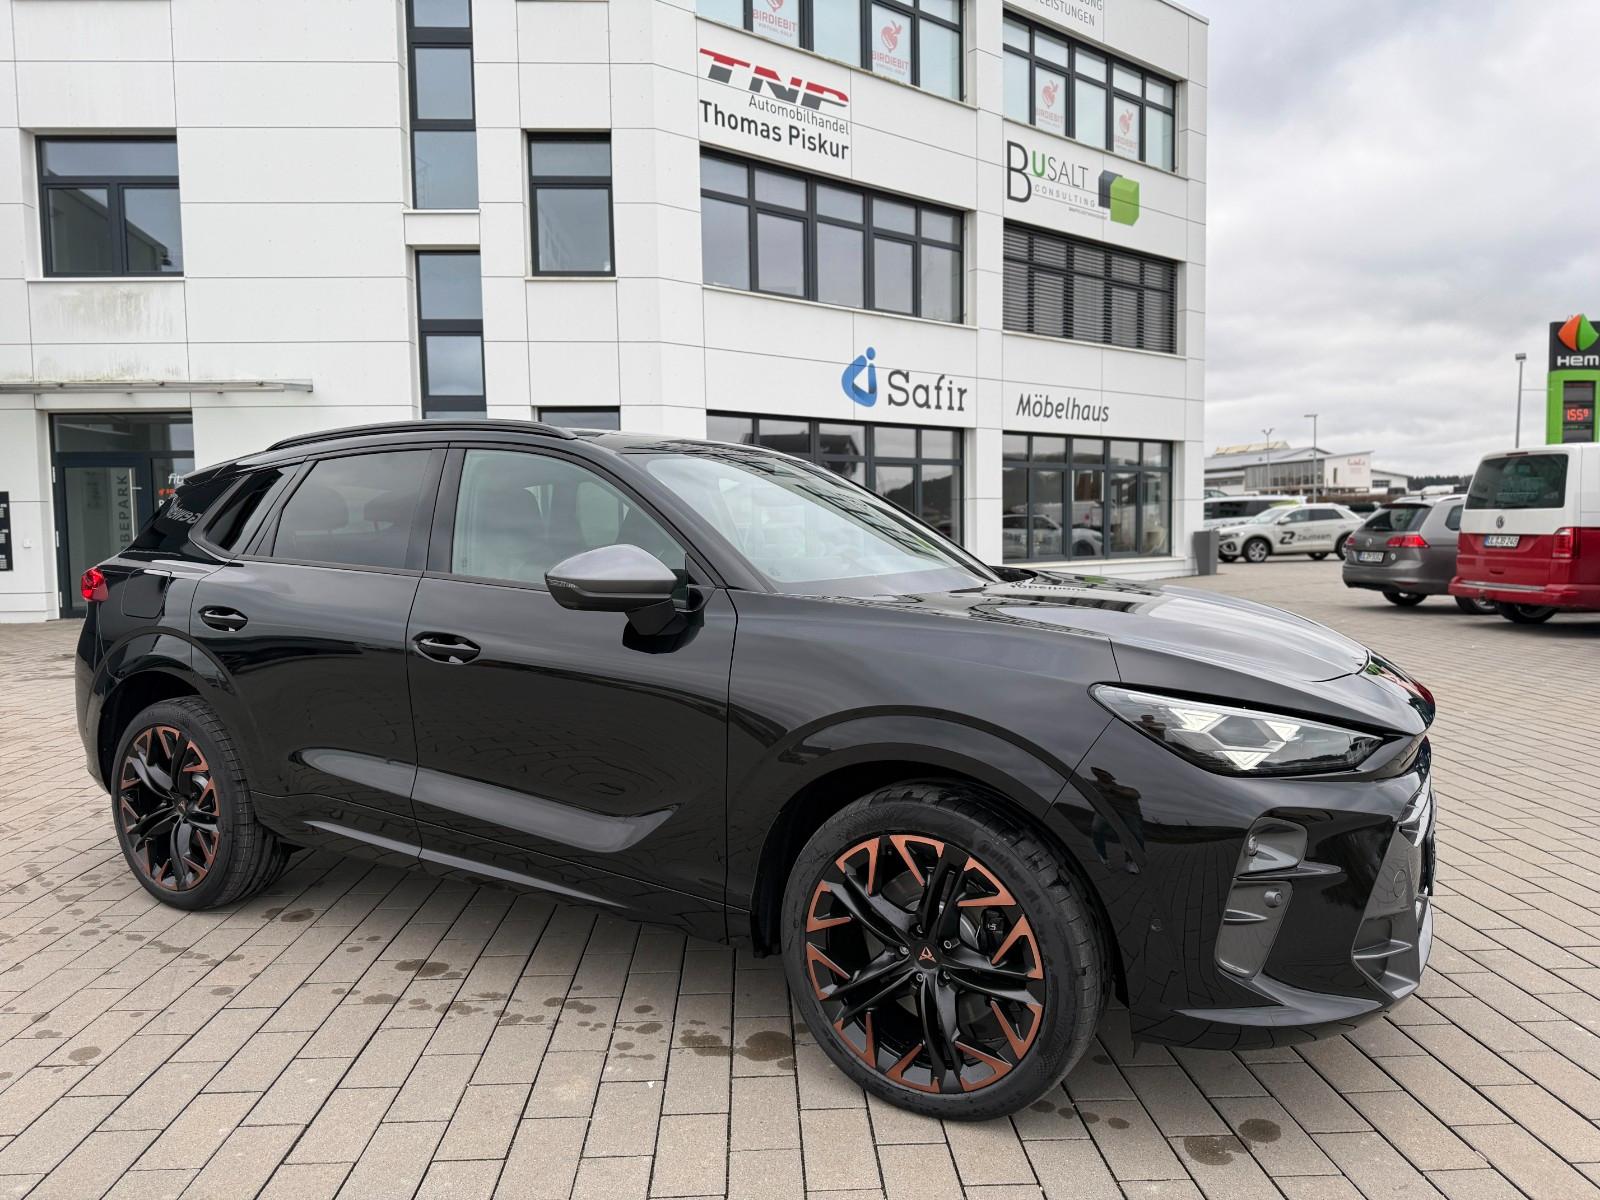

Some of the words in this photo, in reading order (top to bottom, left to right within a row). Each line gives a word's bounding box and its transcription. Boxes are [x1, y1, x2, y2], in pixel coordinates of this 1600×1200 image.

[753, 9, 796, 33] BIRDIEBIT
[699, 47, 850, 110] TNP
[699, 99, 782, 142] Thomas
[788, 125, 849, 159] Piskur
[749, 95, 849, 135] Automobilhandel
[1007, 140, 1088, 203] BUSALT
[1034, 184, 1095, 208] CONSULTING
[887, 369, 967, 412] Safir
[1016, 393, 1110, 423] Möbelhaus
